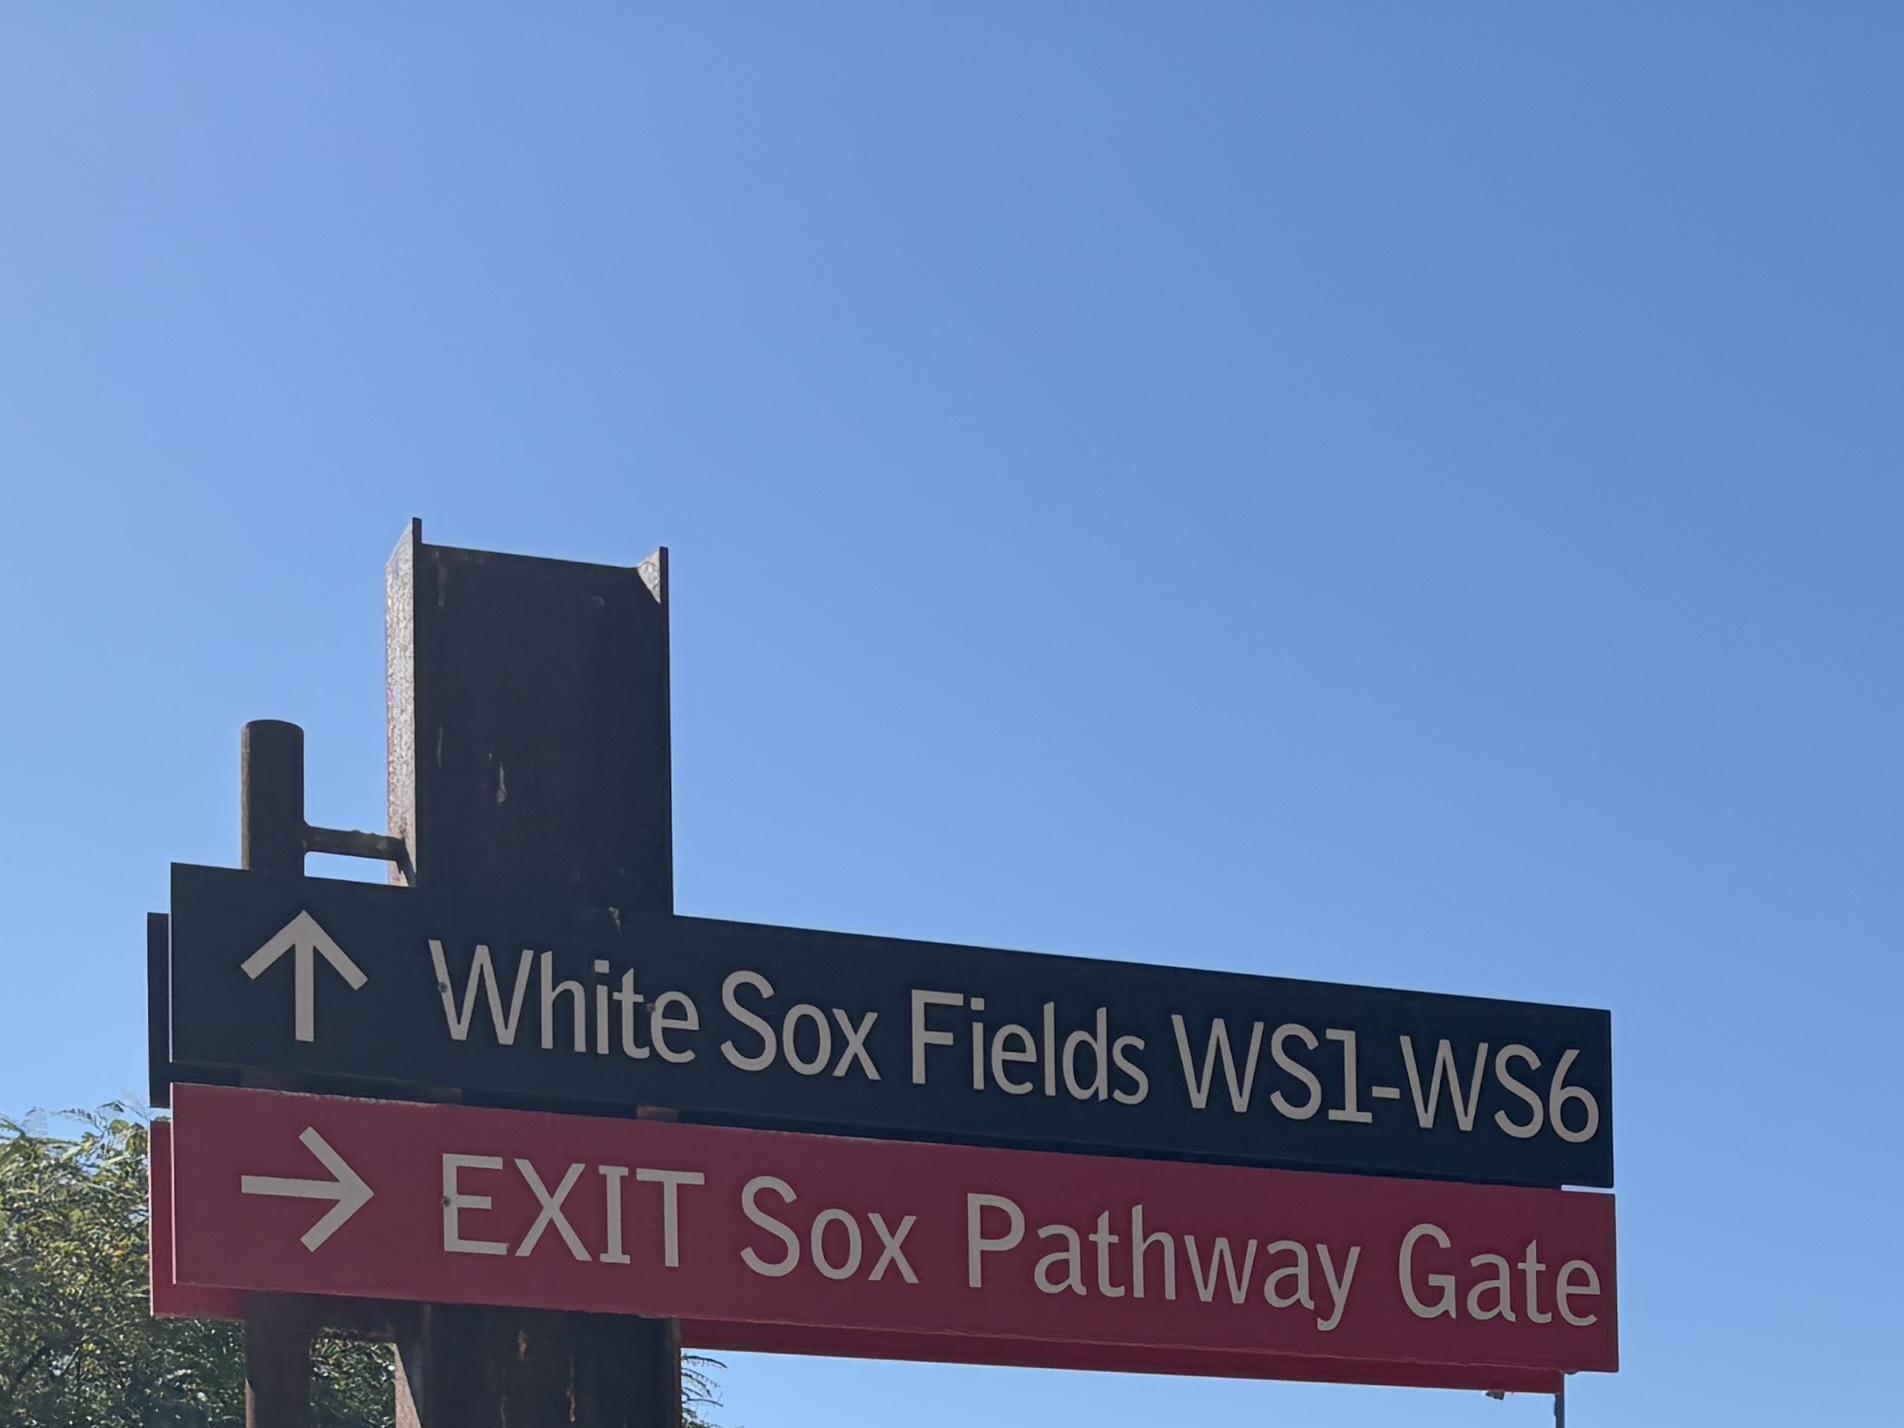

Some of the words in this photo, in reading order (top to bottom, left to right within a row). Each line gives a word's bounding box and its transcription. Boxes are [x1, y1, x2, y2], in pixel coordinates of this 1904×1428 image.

[428, 939, 699, 1063] White
[720, 968, 881, 1081] Sox
[911, 988, 1149, 1104] Fields
[1171, 1014, 1599, 1142] WS1-WS6
[442, 1153, 705, 1268] EXIT
[740, 1175, 919, 1285] Sox
[967, 1193, 1361, 1331] Pathway
[1399, 1222, 1601, 1327] Gate
